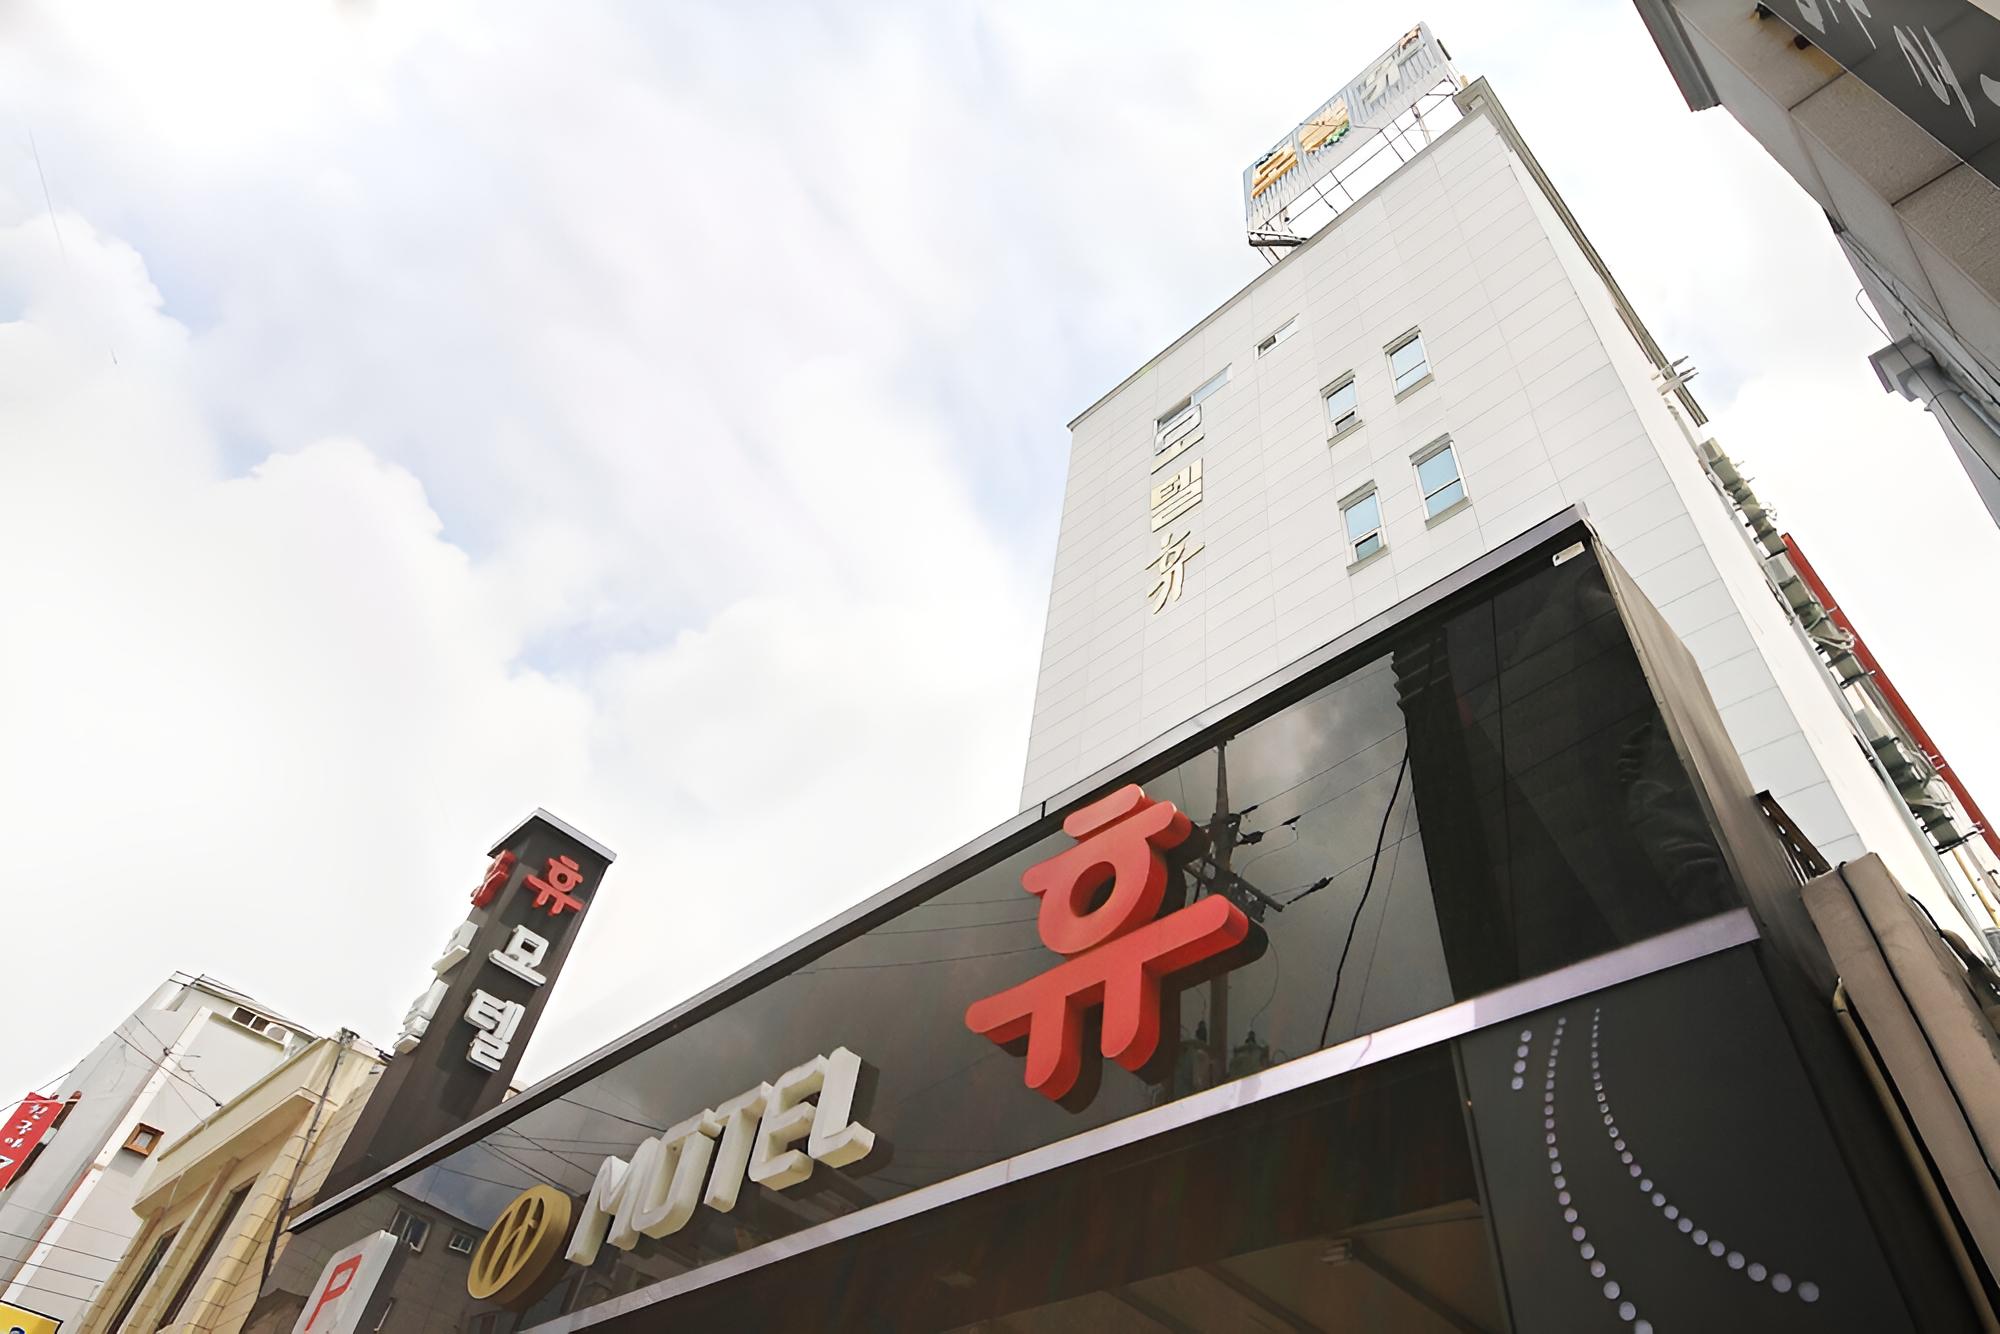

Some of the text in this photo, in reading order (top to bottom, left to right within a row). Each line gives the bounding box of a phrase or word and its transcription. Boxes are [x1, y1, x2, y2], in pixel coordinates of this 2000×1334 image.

[524, 855, 584, 916] 휴
[965, 783, 1250, 1101] 휴
[463, 924, 550, 1073] 모텔
[564, 1046, 876, 1267] MOTEL
[303, 1253, 363, 1332] P
